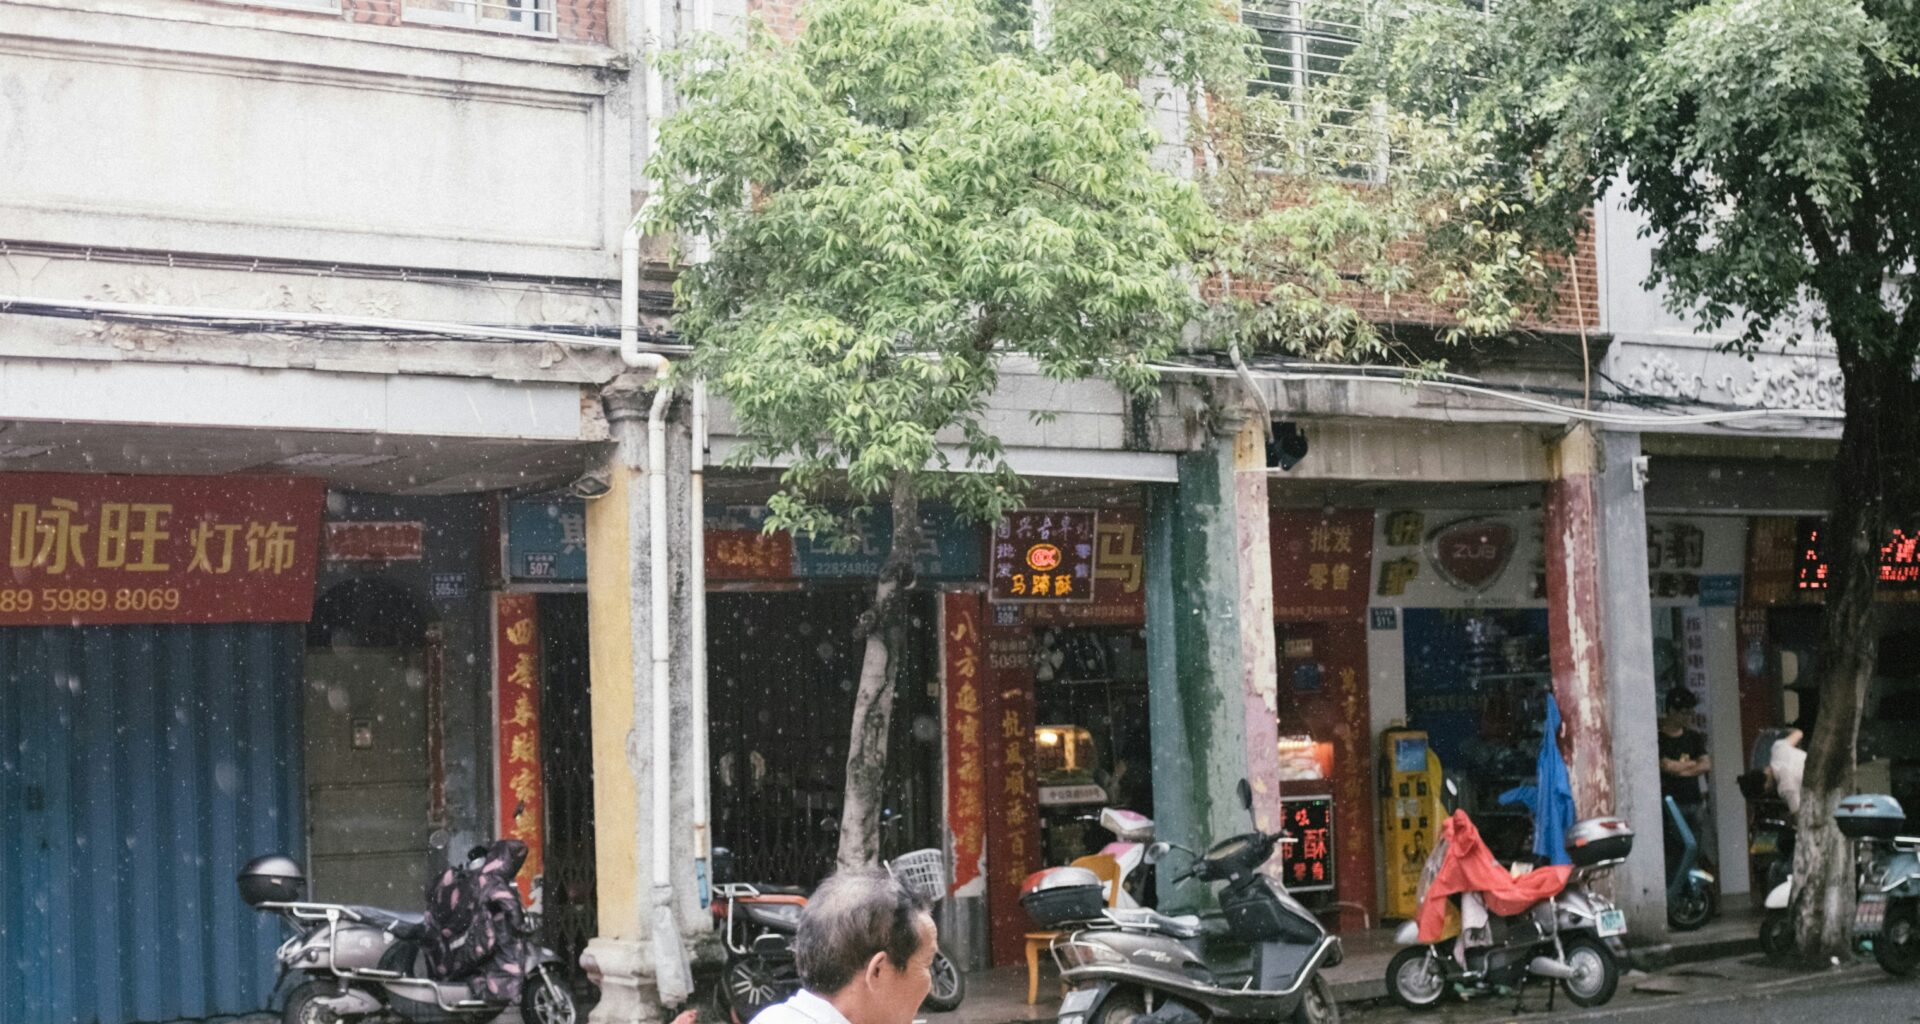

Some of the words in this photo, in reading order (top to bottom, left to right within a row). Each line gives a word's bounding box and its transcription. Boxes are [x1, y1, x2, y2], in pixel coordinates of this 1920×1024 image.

[9, 498, 298, 575] 咏旺灯饰
[1310, 526, 1351, 553] 批发
[1010, 573, 1073, 597] 马蹄酥
[1308, 563, 1350, 590] 零售
[0, 589, 33, 612] 89
[42, 588, 107, 612] 5989
[115, 588, 180, 611] 8069
